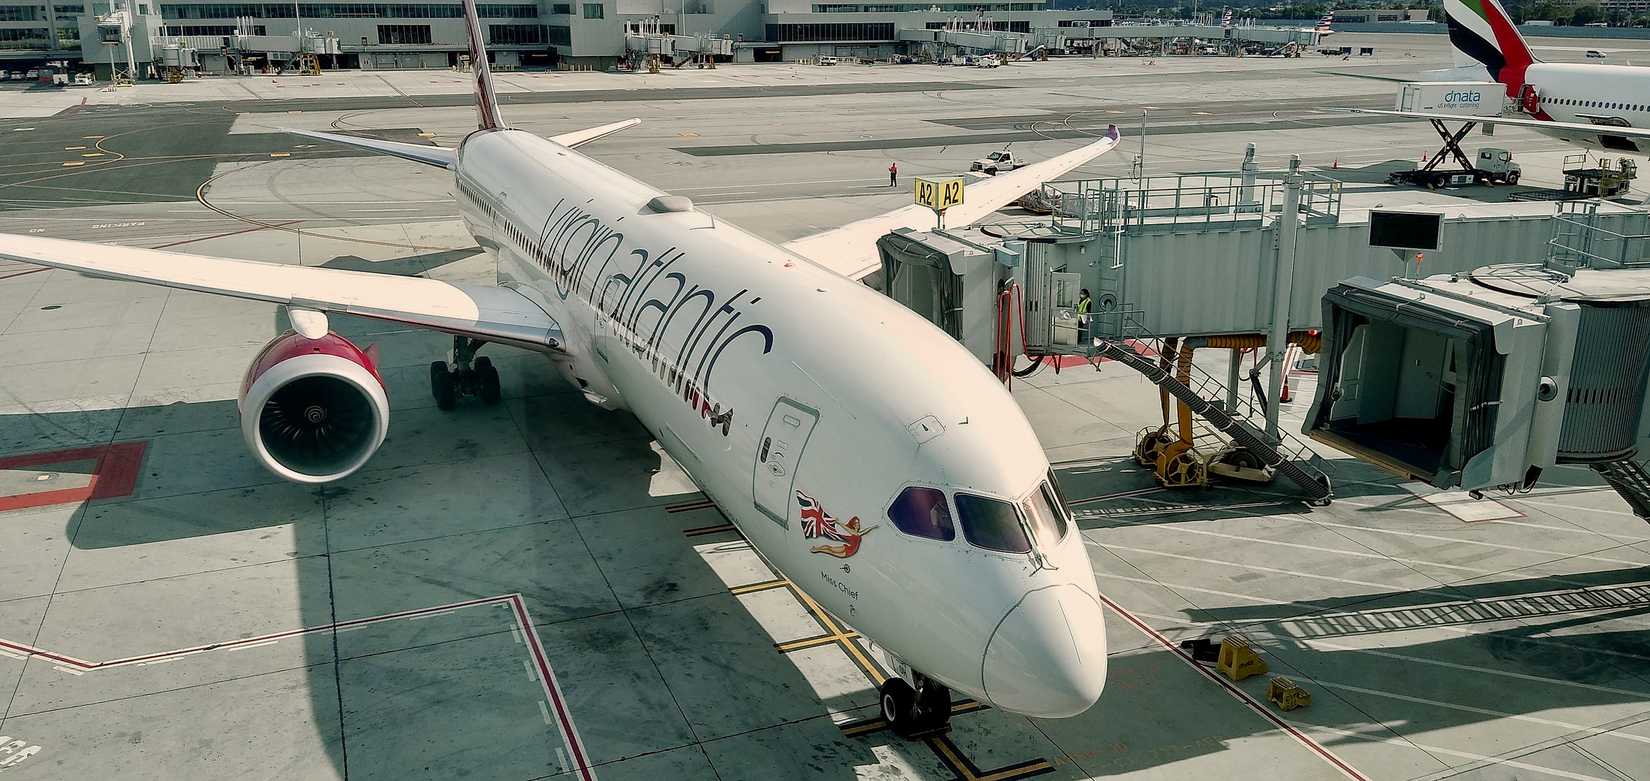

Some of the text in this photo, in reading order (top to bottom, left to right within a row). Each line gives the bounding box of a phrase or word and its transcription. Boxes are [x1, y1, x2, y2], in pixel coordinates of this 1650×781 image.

[1445, 90, 1480, 102] dnata
[919, 182, 932, 205] A2
[943, 182, 959, 206] A2
[600, 246, 774, 402] atlantic
[821, 570, 859, 601] Miss Chief
